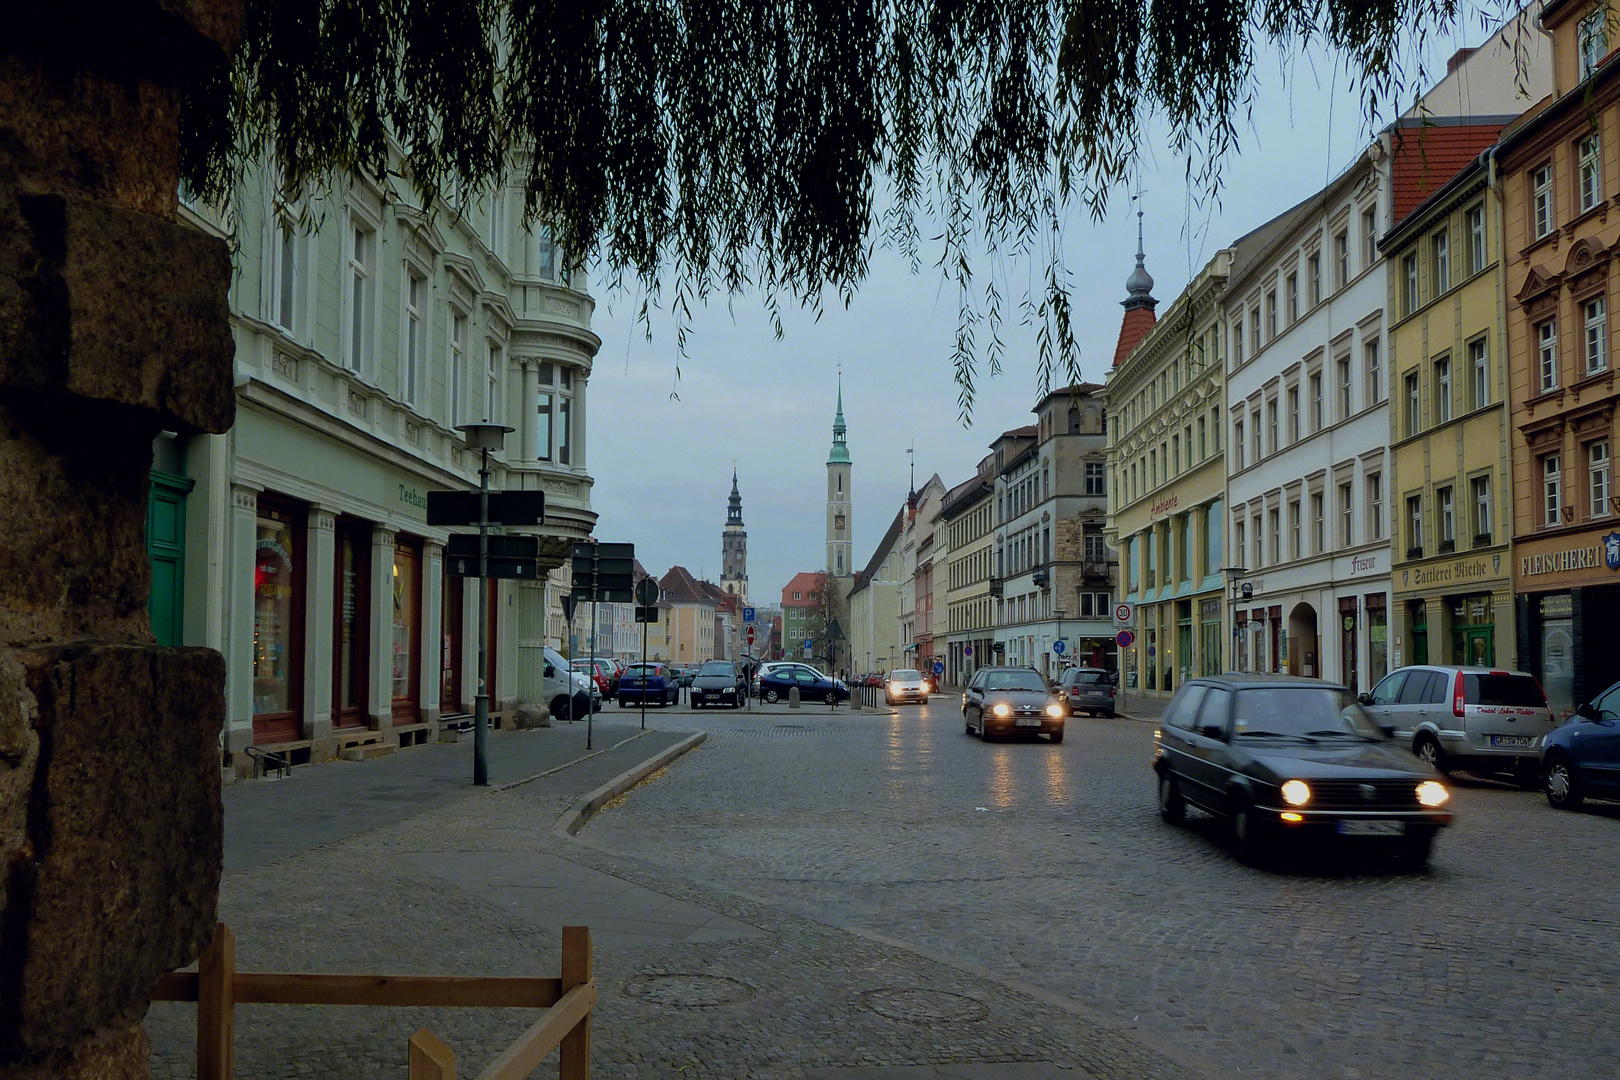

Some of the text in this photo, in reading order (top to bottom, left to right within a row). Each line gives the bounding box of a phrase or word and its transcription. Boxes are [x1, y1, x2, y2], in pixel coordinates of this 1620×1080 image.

[399, 484, 427, 510] Teehau
[1150, 494, 1178, 519] Ambiente
[1351, 557, 1375, 575] Friseur
[1414, 560, 1486, 585] Sattlerei Miethe
[1522, 546, 1600, 576] FLEISCHEREI
[745, 609, 752, 619] P
[1119, 609, 1128, 617] 30
